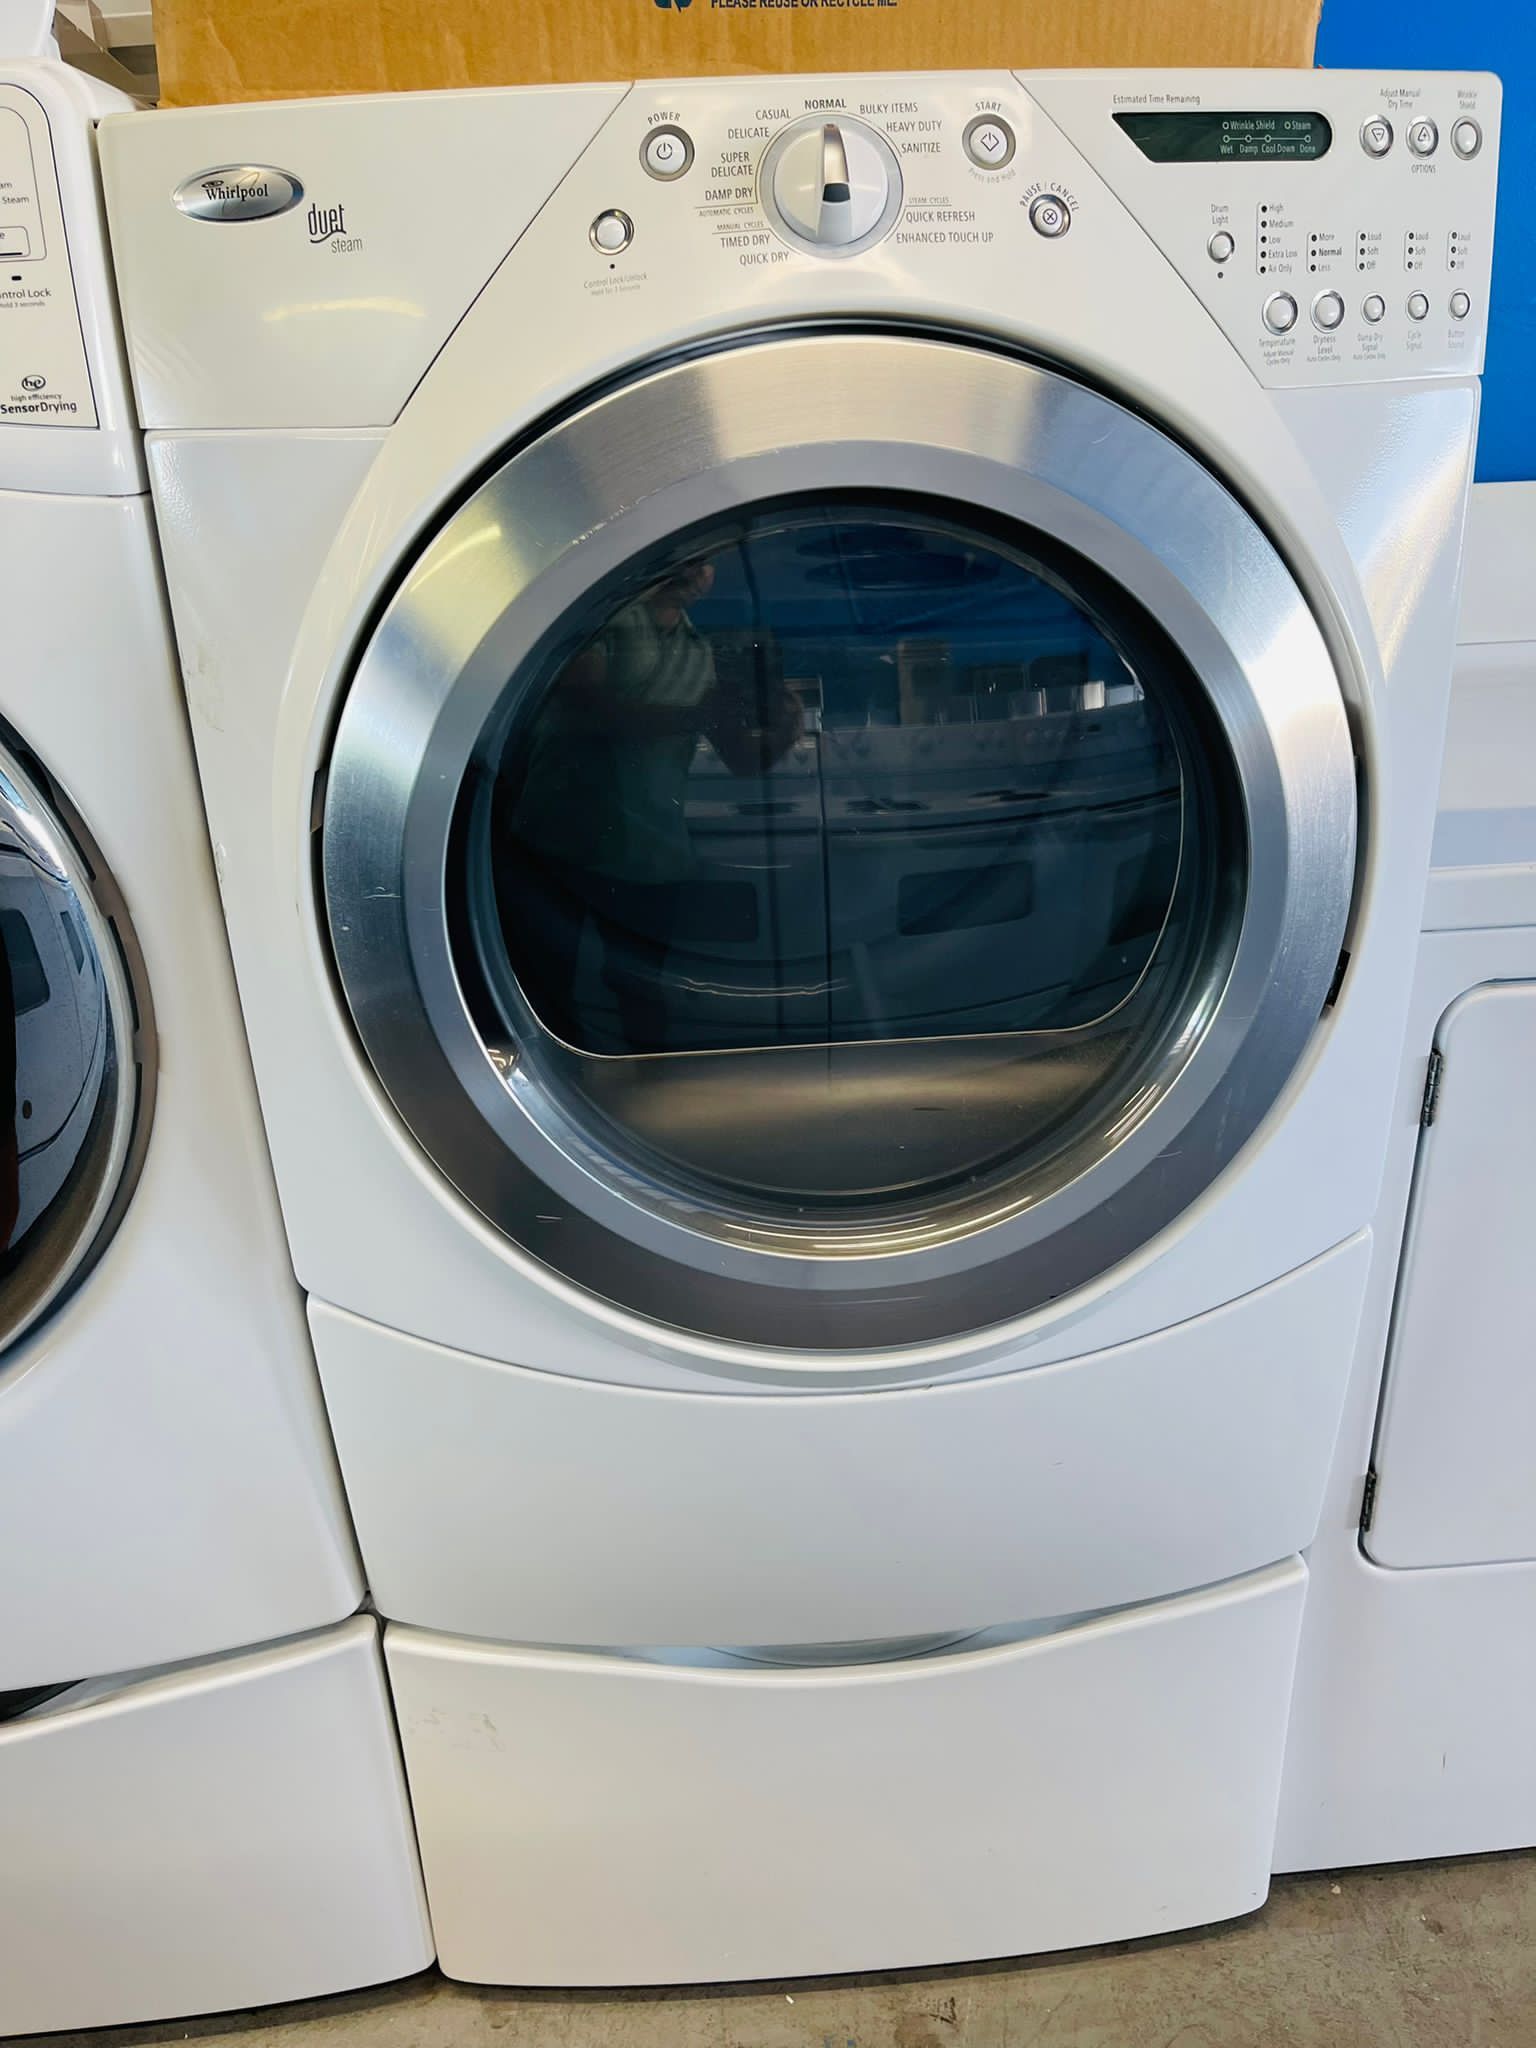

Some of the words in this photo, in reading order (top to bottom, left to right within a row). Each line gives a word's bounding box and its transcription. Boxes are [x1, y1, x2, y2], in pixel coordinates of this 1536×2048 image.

[1380, 88, 1398, 99] Adjust
[1400, 88, 1421, 97] Manual
[804, 98, 847, 110] NORMAL
[1113, 95, 1147, 104] Estimated
[1149, 95, 1164, 103] Time
[1166, 94, 1201, 105] Remaining
[860, 103, 888, 114] BULKY
[891, 102, 919, 113] ITEMS
[975, 100, 1002, 113] START
[647, 111, 681, 125] POWER
[756, 109, 791, 120] CASUAL
[886, 121, 916, 132] HEAVY
[919, 120, 943, 131] DUTY
[1230, 120, 1255, 130] Wrinkle
[1256, 120, 1275, 130] Shield
[1292, 121, 1311, 130] Steam
[728, 127, 770, 139] DELICATE
[901, 142, 941, 153] SANITIZE
[1220, 145, 1233, 154] Wet
[1240, 145, 1258, 155] Damp
[1261, 144, 1276, 154] Cool
[1277, 145, 1296, 154] Down
[1300, 145, 1316, 154] Done
[720, 152, 750, 163] SUPER
[711, 165, 753, 178] DELICATE
[1411, 164, 1436, 174] OPTIONS
[206, 184, 268, 202] Whirlpool
[705, 188, 733, 201] DAMP
[735, 187, 754, 199] DRY
[1019, 182, 1041, 207] PAUSE
[1050, 182, 1080, 212] CANCEL
[699, 208, 731, 217] AUTOMATIC
[733, 207, 754, 215] CYCLES
[1210, 204, 1229, 213] Drum
[1269, 203, 1284, 214] High
[906, 212, 934, 223] QUICK
[937, 211, 975, 222] REFRESH
[1212, 215, 1229, 226] Light
[308, 203, 347, 243] duet
[716, 222, 741, 231] MANUAL
[744, 221, 764, 229] CYCLES
[1268, 219, 1294, 228] Medium
[720, 236, 750, 248] TIMED
[752, 234, 770, 246] DRY
[896, 232, 946, 244] ENHANCED
[949, 232, 979, 242] TOUCH
[982, 232, 994, 242] UP
[331, 238, 363, 253] steam
[1268, 250, 1284, 259] Extra
[1318, 247, 1342, 256] Normal
[739, 253, 769, 265] QUICK
[771, 251, 789, 262] DRY
[0, 290, 25, 300] ntrol
[27, 288, 52, 298] Lock
[28, 393, 62, 401] efficiency
[0, 402, 77, 414] SensorDrying
